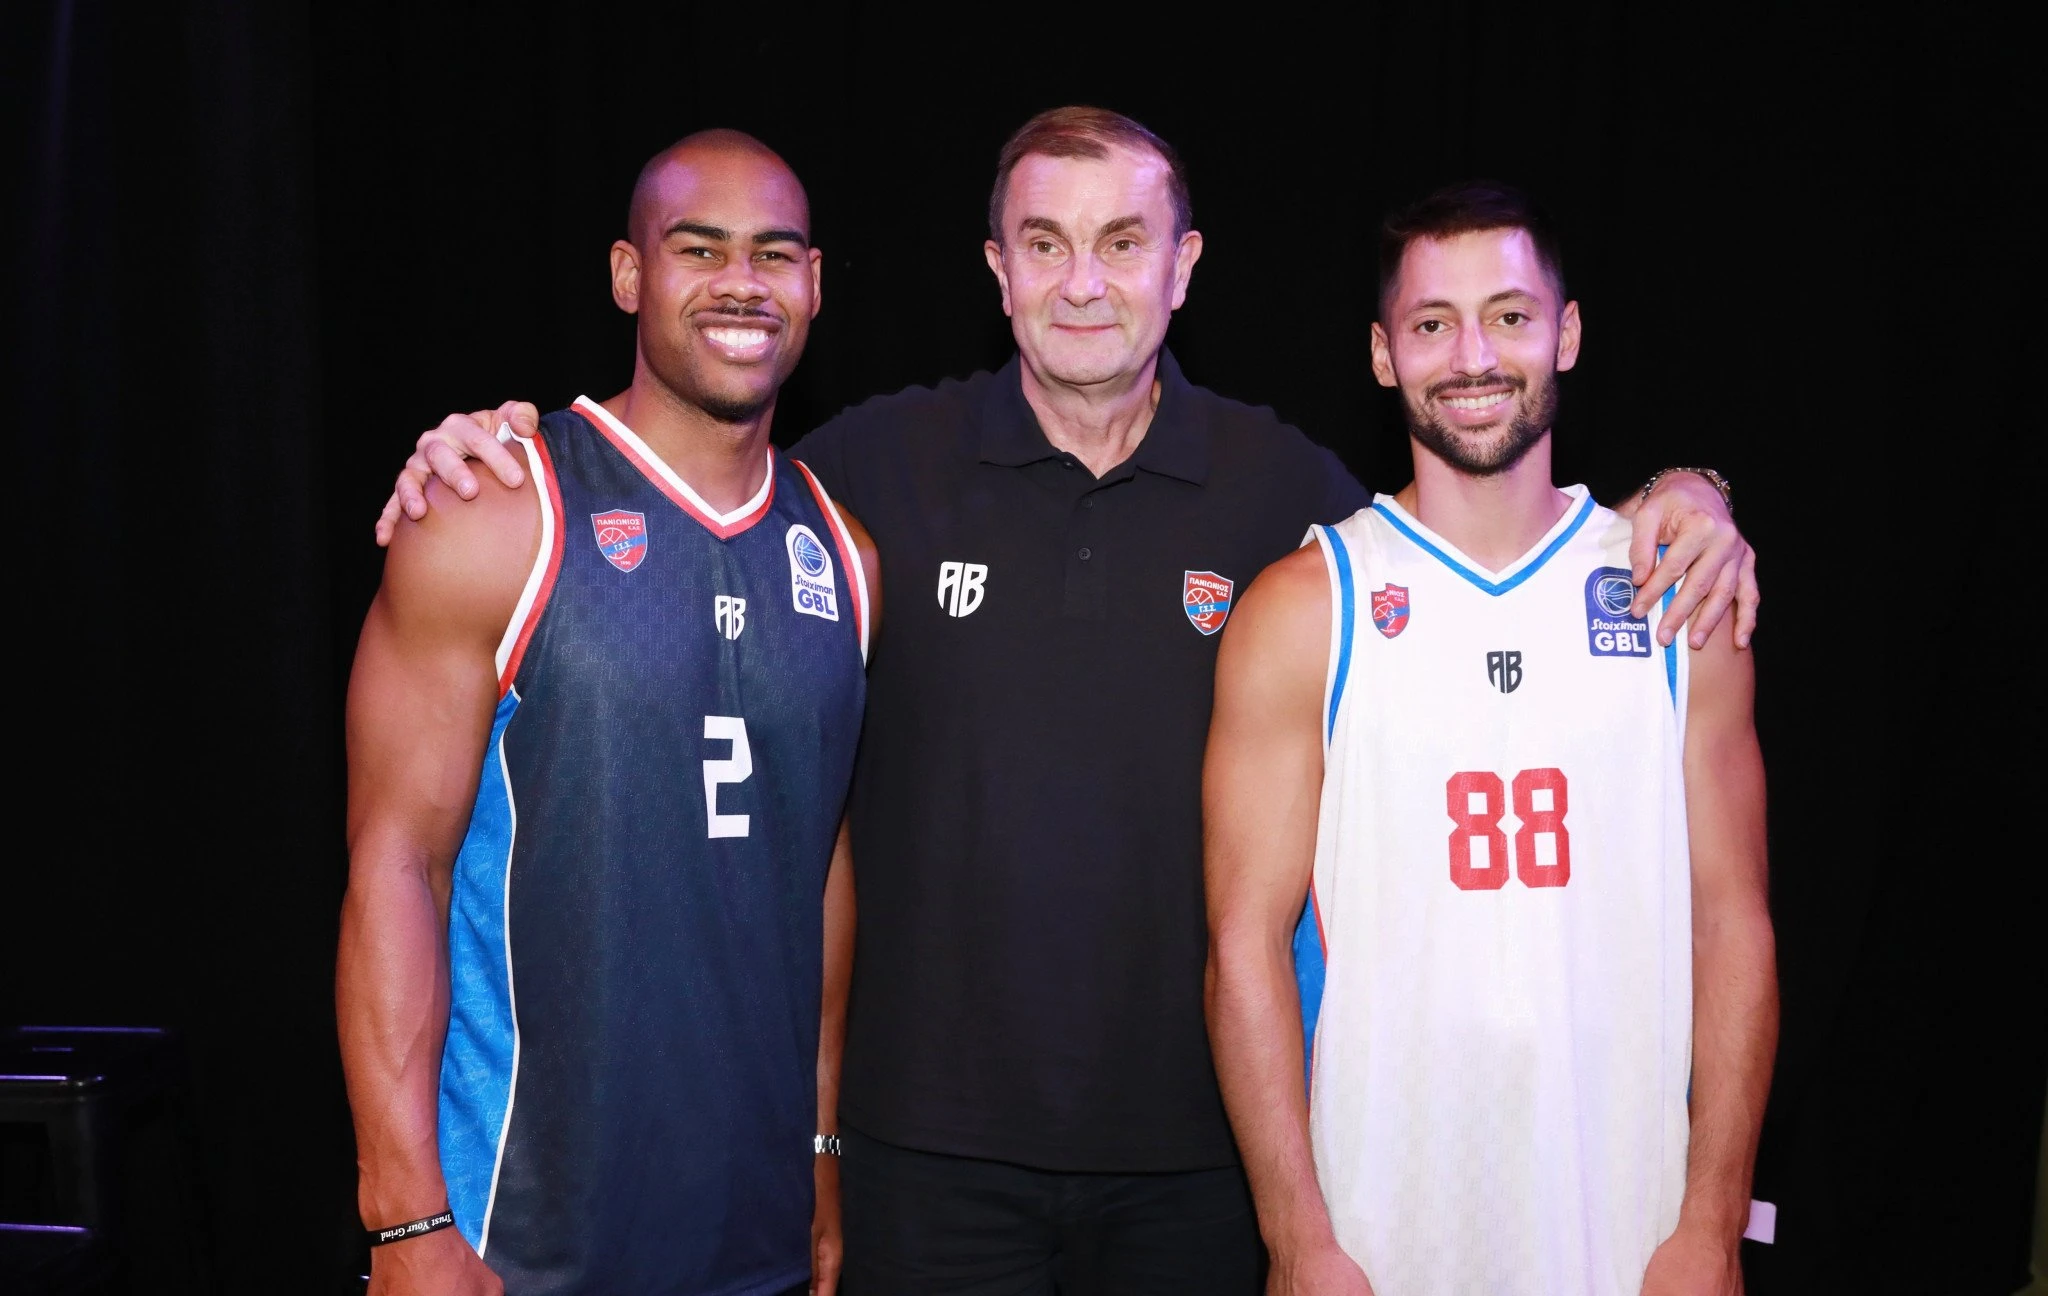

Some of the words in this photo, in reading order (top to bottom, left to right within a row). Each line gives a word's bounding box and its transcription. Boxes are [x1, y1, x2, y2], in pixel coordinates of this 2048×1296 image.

[795, 574, 834, 595] Stoiximan
[797, 588, 835, 615] GBL
[1591, 619, 1647, 631] Stoiximan
[1594, 631, 1647, 653] GBL
[703, 715, 753, 839] 2
[1446, 767, 1571, 891] 88
[407, 1223, 430, 1233] Your
[431, 1213, 452, 1227] Trust
[380, 1227, 405, 1242] Grind
